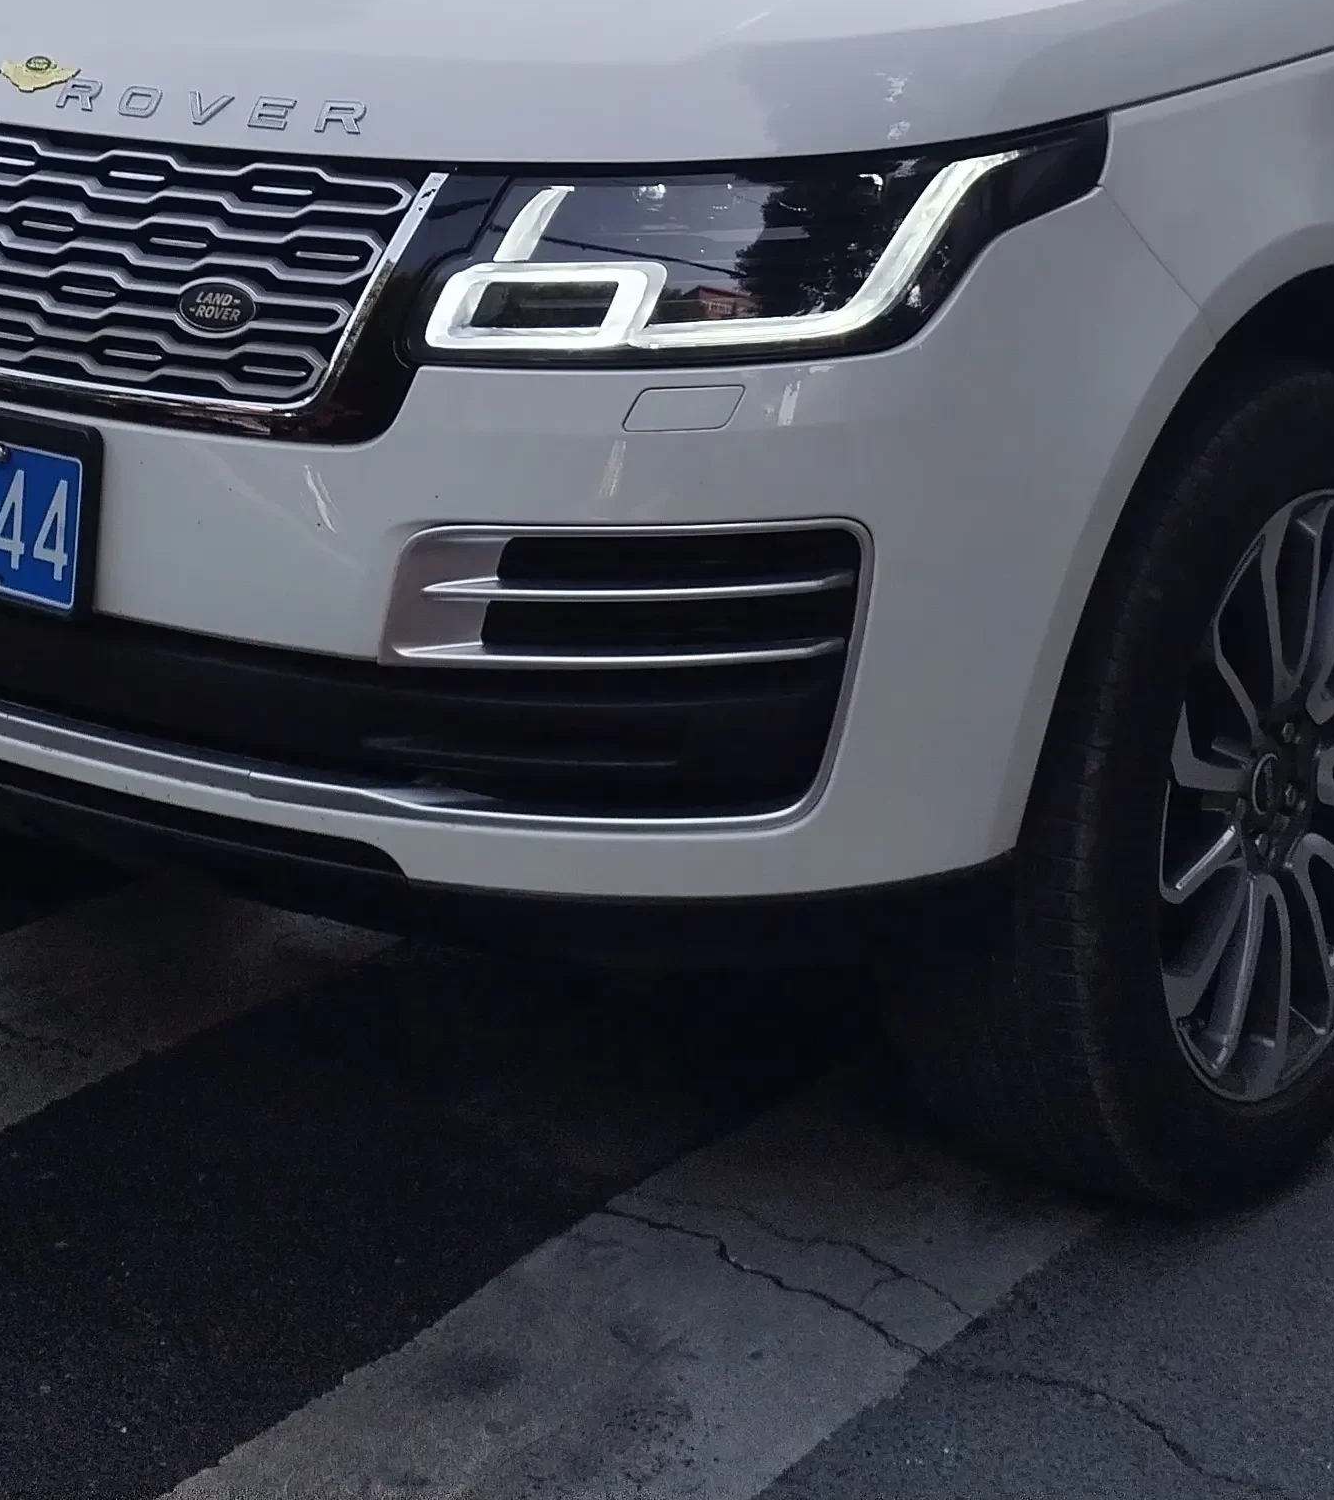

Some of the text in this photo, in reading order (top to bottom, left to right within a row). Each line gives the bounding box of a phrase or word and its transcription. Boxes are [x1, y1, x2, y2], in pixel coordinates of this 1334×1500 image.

[55, 78, 368, 134] ROVER
[195, 291, 233, 306] LAND
[195, 305, 241, 322] ROVER
